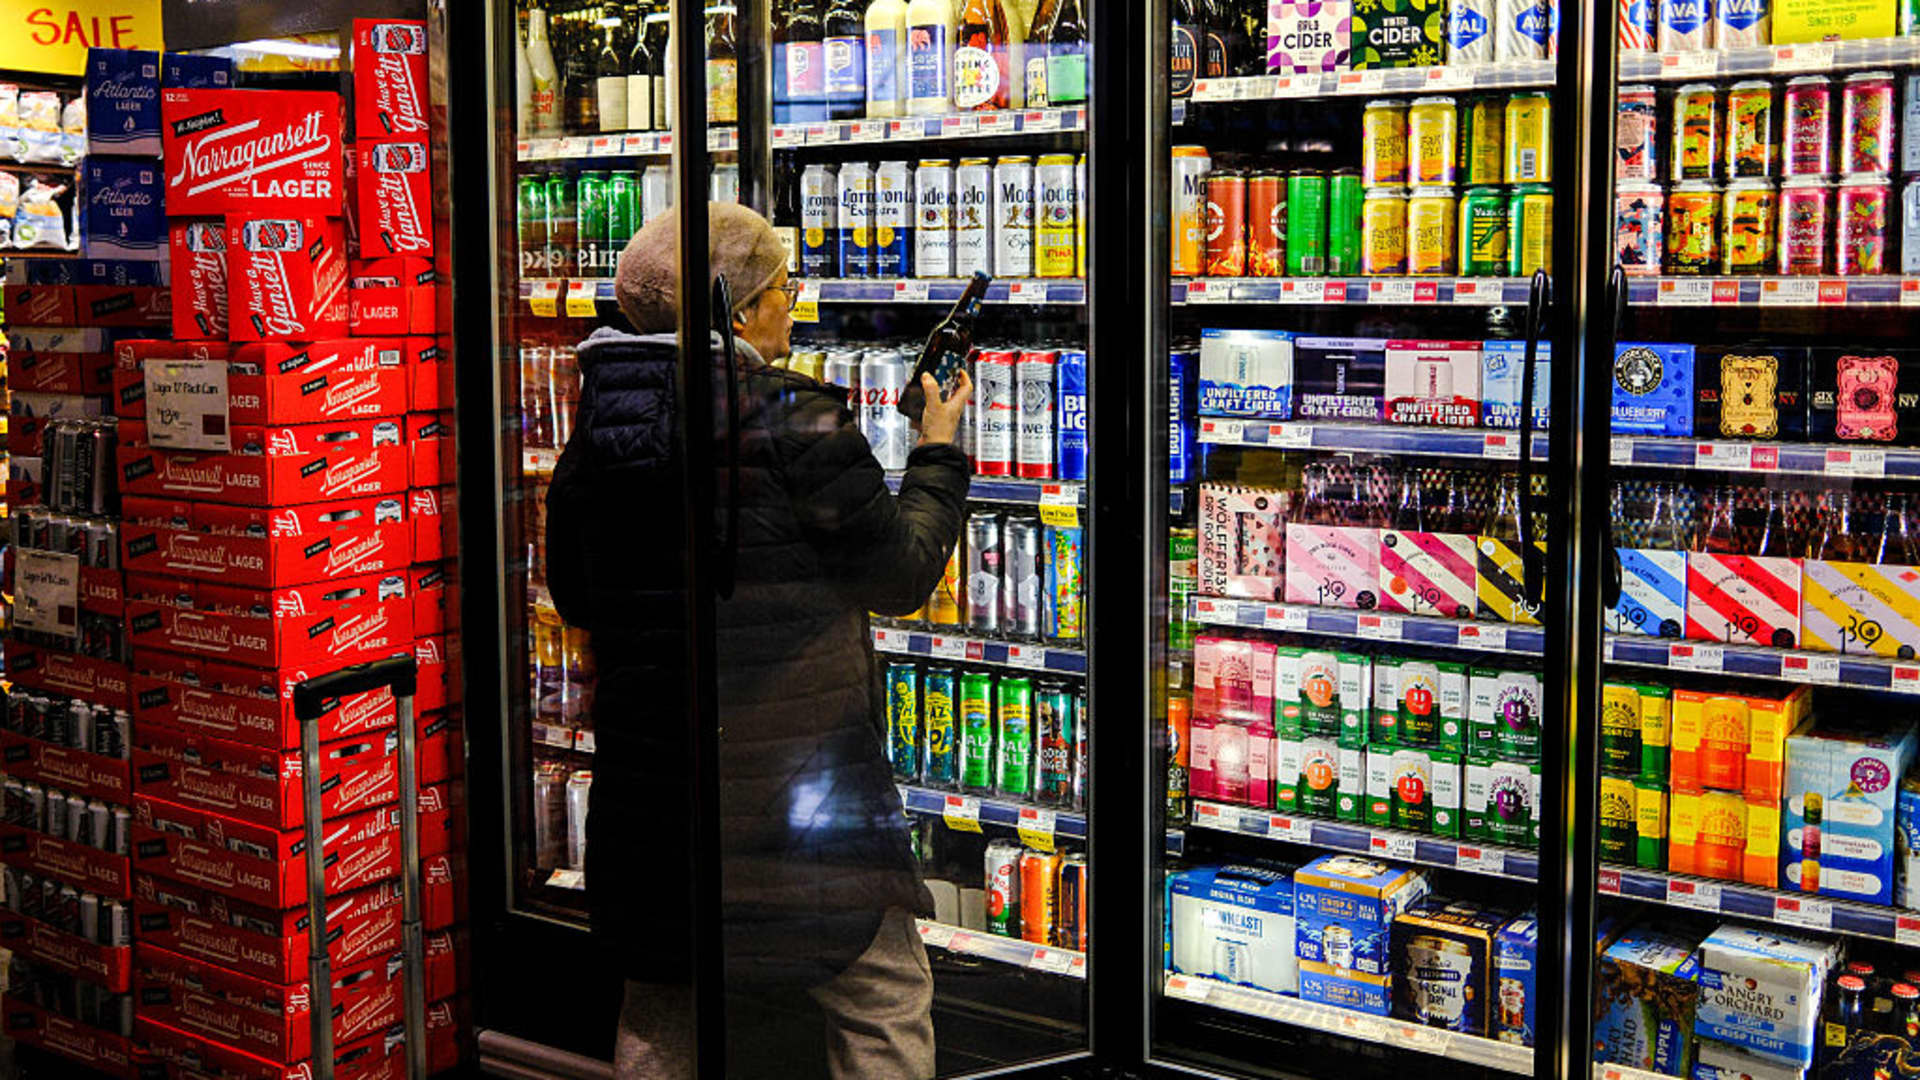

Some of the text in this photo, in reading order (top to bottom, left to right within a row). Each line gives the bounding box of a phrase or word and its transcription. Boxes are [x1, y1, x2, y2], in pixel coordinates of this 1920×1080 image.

[26, 9, 138, 51] SALE
[1369, 28, 1422, 45] CIDER
[1284, 33, 1333, 49] CIDER
[93, 80, 156, 99] Atlantic
[378, 54, 430, 132] Gansett
[171, 110, 332, 194] Narragansett
[303, 161, 331, 170] SINCE
[92, 187, 153, 206] Atlantic
[252, 179, 332, 198] LAGER
[379, 173, 431, 252] Gansett
[250, 252, 305, 336] Gansett
[363, 306, 398, 319] LAGER
[230, 395, 260, 409] AGER
[1206, 387, 1277, 400] UNFILTERED
[1302, 393, 1375, 407] UNFILTERED
[1814, 391, 1834, 401] SIX
[1899, 396, 1919, 408] NY
[352, 404, 381, 415] LAGER
[1201, 398, 1281, 411] CRAFT CIDER
[1300, 405, 1378, 418] CRAFT CIDER
[1396, 402, 1470, 415] UNFILTERED
[1391, 412, 1475, 426] CRAFT CIDER
[226, 474, 261, 488] LAGER
[352, 482, 381, 494] LAGER
[1204, 496, 1214, 521] DRY
[1215, 498, 1231, 594] WÖLFFER139
[228, 554, 264, 570] LAGER
[354, 560, 384, 572] LAGER
[1317, 577, 1346, 605] 139
[1411, 585, 1441, 611] 139
[1614, 604, 1648, 634] 139
[1724, 613, 1759, 643] 139
[1838, 614, 1883, 655] 139
[232, 634, 268, 651] LAGER
[358, 637, 388, 650] LAGER
[239, 714, 275, 731] LAGER
[1727, 985, 1775, 1006] ANGRY
[1715, 994, 1784, 1021] ORCHARD
[1656, 1023, 1672, 1066] APPLE
[1713, 1026, 1785, 1050] CRISP LIGHT
